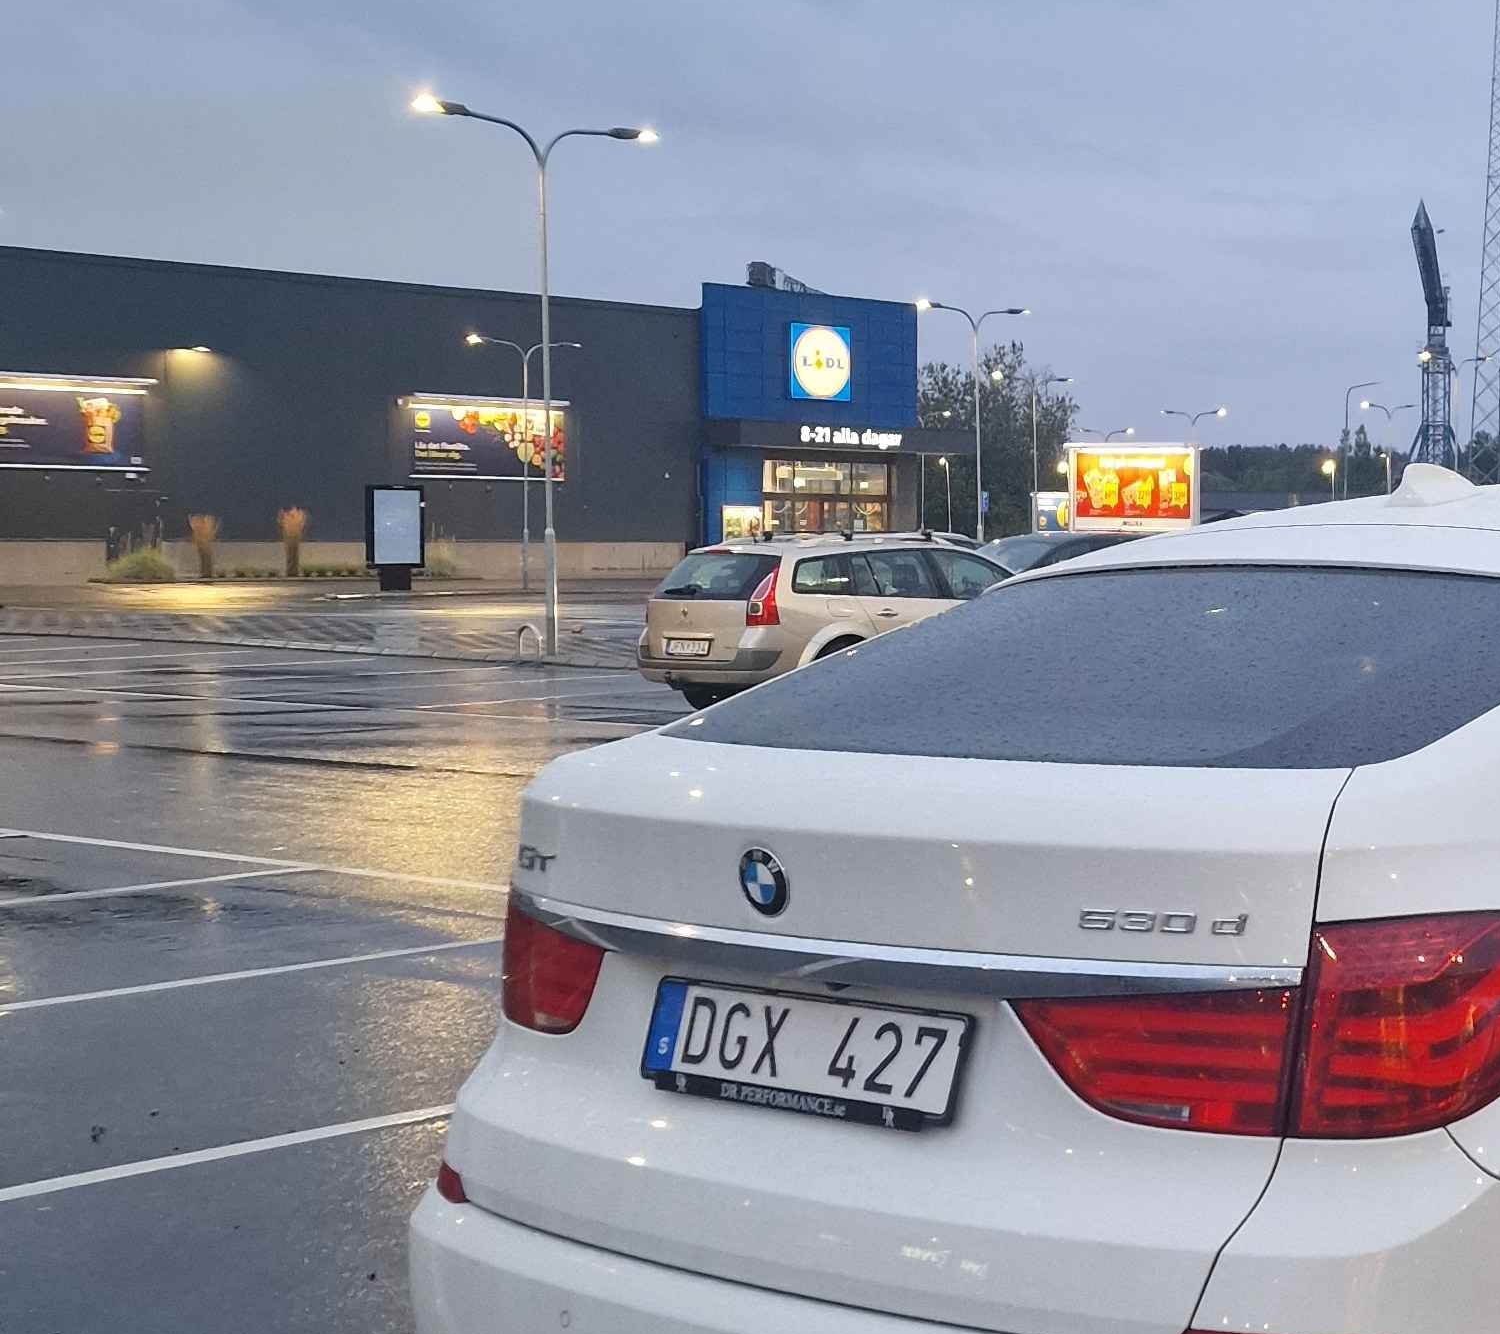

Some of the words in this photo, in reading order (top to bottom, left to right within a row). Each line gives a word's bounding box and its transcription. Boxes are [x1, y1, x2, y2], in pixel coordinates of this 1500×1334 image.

[800, 425, 831, 443] 8-21
[833, 427, 860, 445] alla
[861, 429, 902, 450] dagar
[1079, 907, 1198, 934] 530
[1211, 913, 1249, 935] d
[657, 1036, 669, 1055] S
[680, 995, 791, 1078] DGX
[827, 1017, 949, 1099] 427
